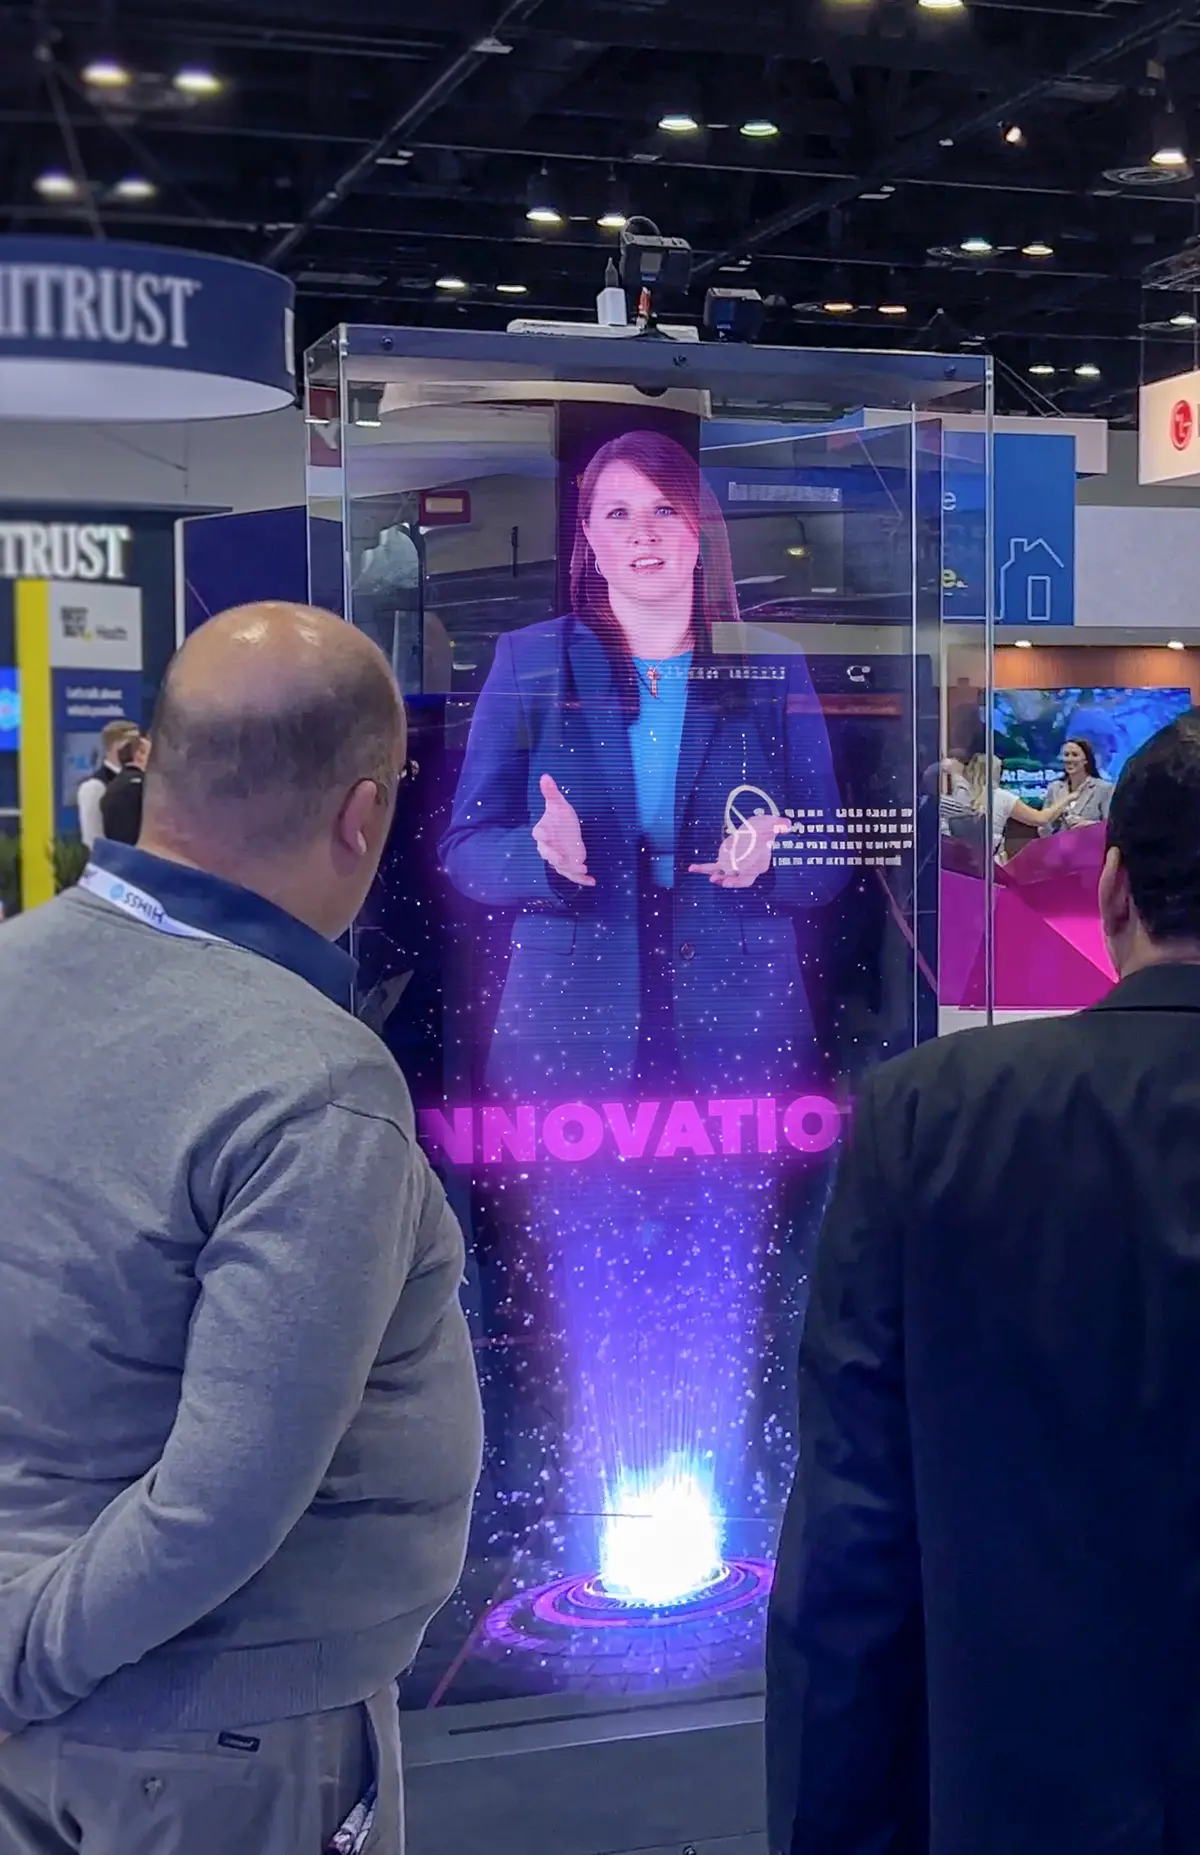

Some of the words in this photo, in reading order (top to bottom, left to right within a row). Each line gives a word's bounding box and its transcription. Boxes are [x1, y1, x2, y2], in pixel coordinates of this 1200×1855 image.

[0, 520, 132, 580] TRUST
[123, 891, 165, 924] HIMSS
[416, 1094, 841, 1165] NNOVATIO
